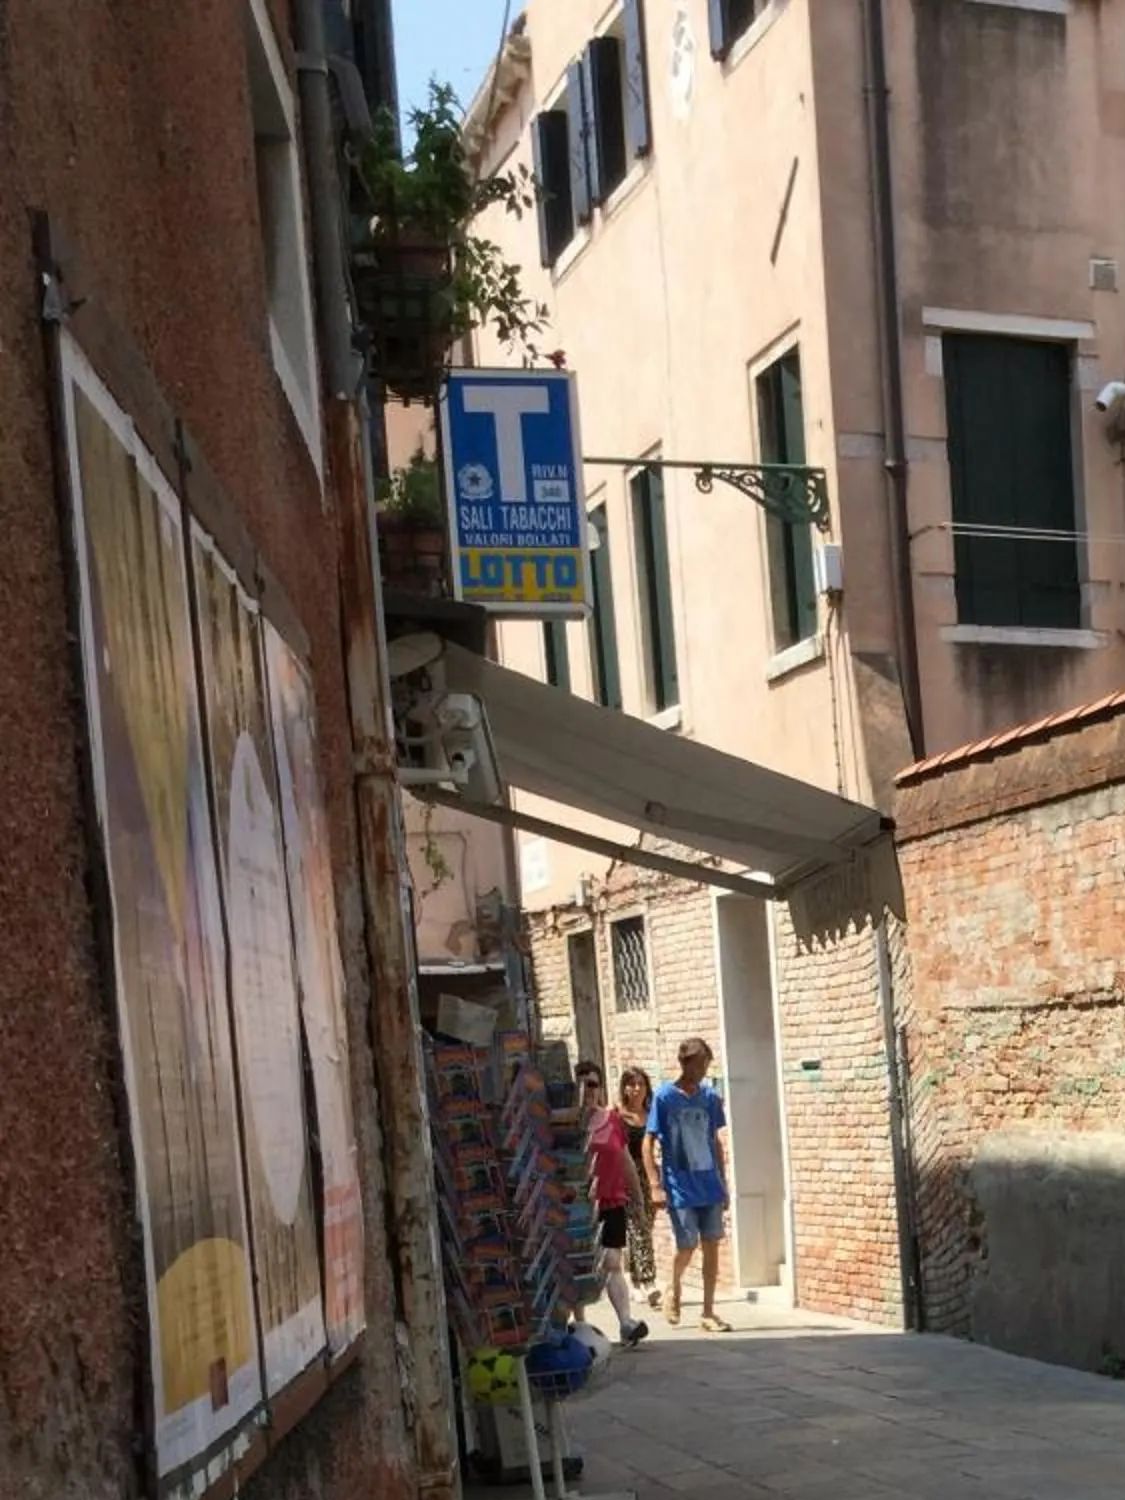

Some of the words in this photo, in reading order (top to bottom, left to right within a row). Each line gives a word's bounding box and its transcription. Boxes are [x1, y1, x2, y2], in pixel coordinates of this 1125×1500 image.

[462, 385, 549, 502] T
[461, 504, 493, 530] SALI
[501, 504, 571, 531] TABACCHI
[465, 533, 513, 546] VALORI
[517, 533, 570, 546] BOLLATI
[461, 555, 577, 588] LOTTO
